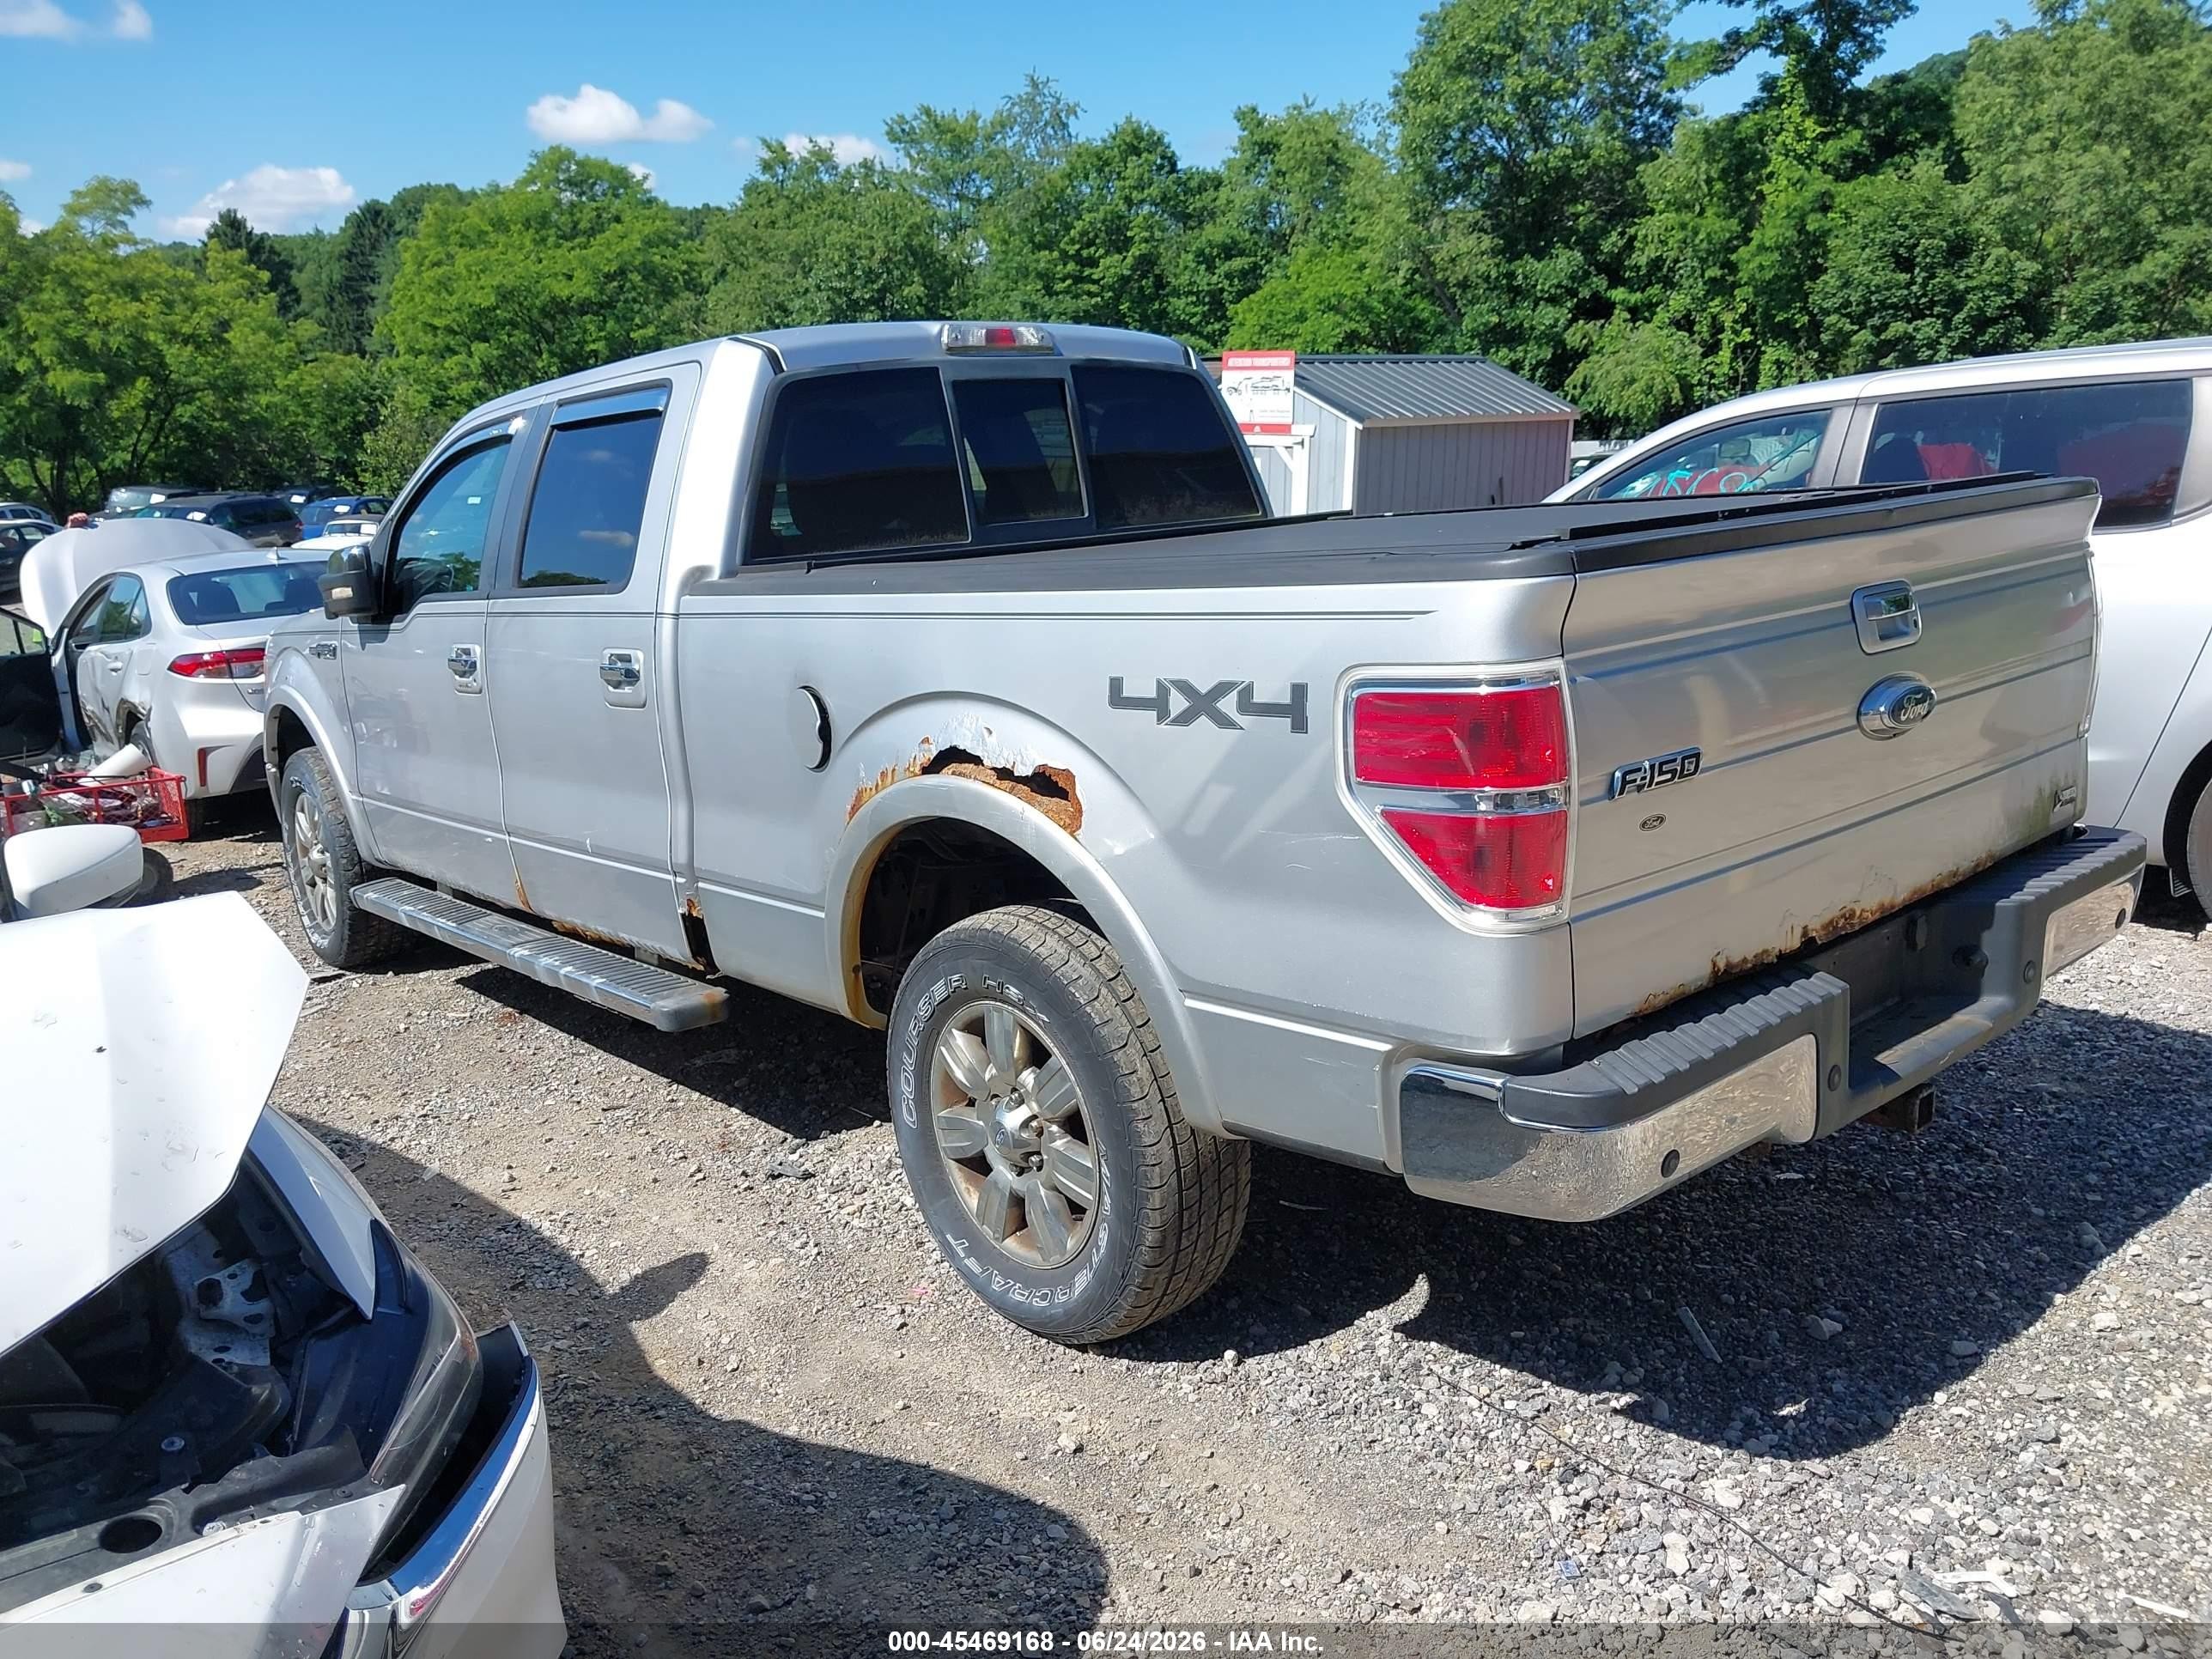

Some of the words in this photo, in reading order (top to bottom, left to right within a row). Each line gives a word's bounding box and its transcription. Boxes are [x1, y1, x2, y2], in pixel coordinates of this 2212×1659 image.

[1108, 676, 1309, 734] 4X4
[1899, 690, 1931, 722] Ford
[1614, 750, 1702, 799] F-150
[901, 973, 969, 1129] COURSER
[981, 974, 1051, 1029] HSX
